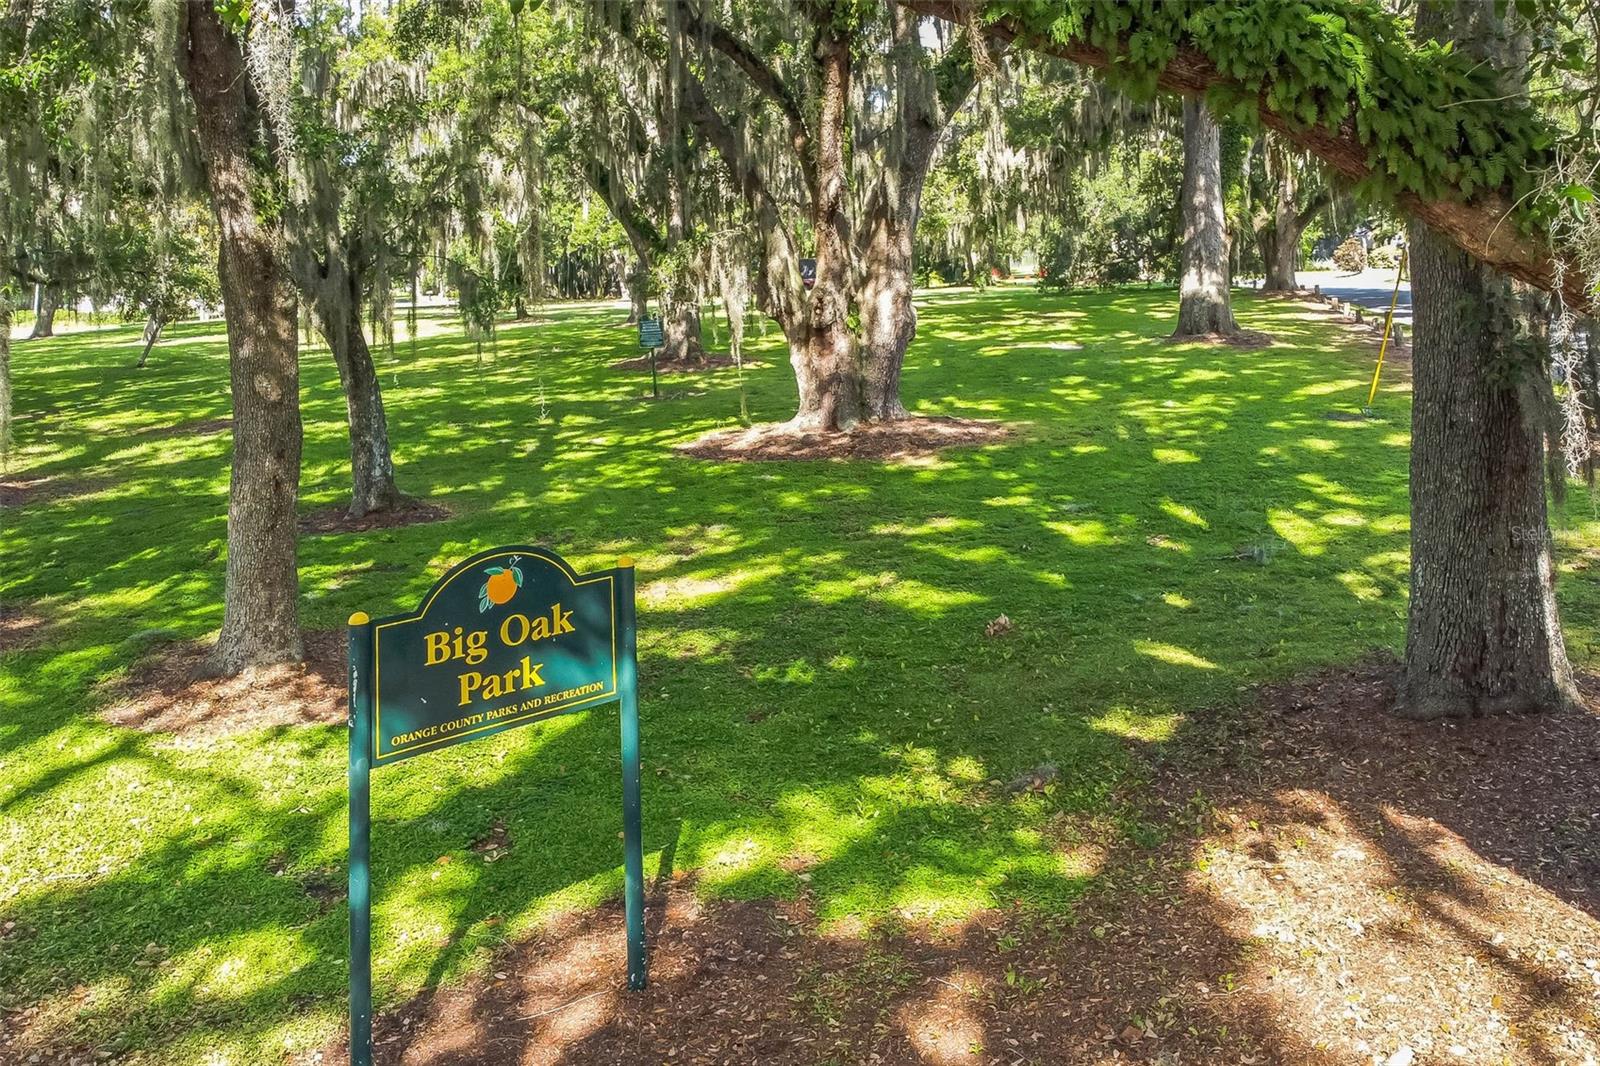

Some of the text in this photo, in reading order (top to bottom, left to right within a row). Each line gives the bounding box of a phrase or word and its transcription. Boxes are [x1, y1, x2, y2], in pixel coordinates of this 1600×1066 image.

[424, 602, 576, 666] Big Oak
[457, 655, 546, 707] Park
[390, 681, 604, 747] ORANGE COUNTY PARKS AND RECREATION
